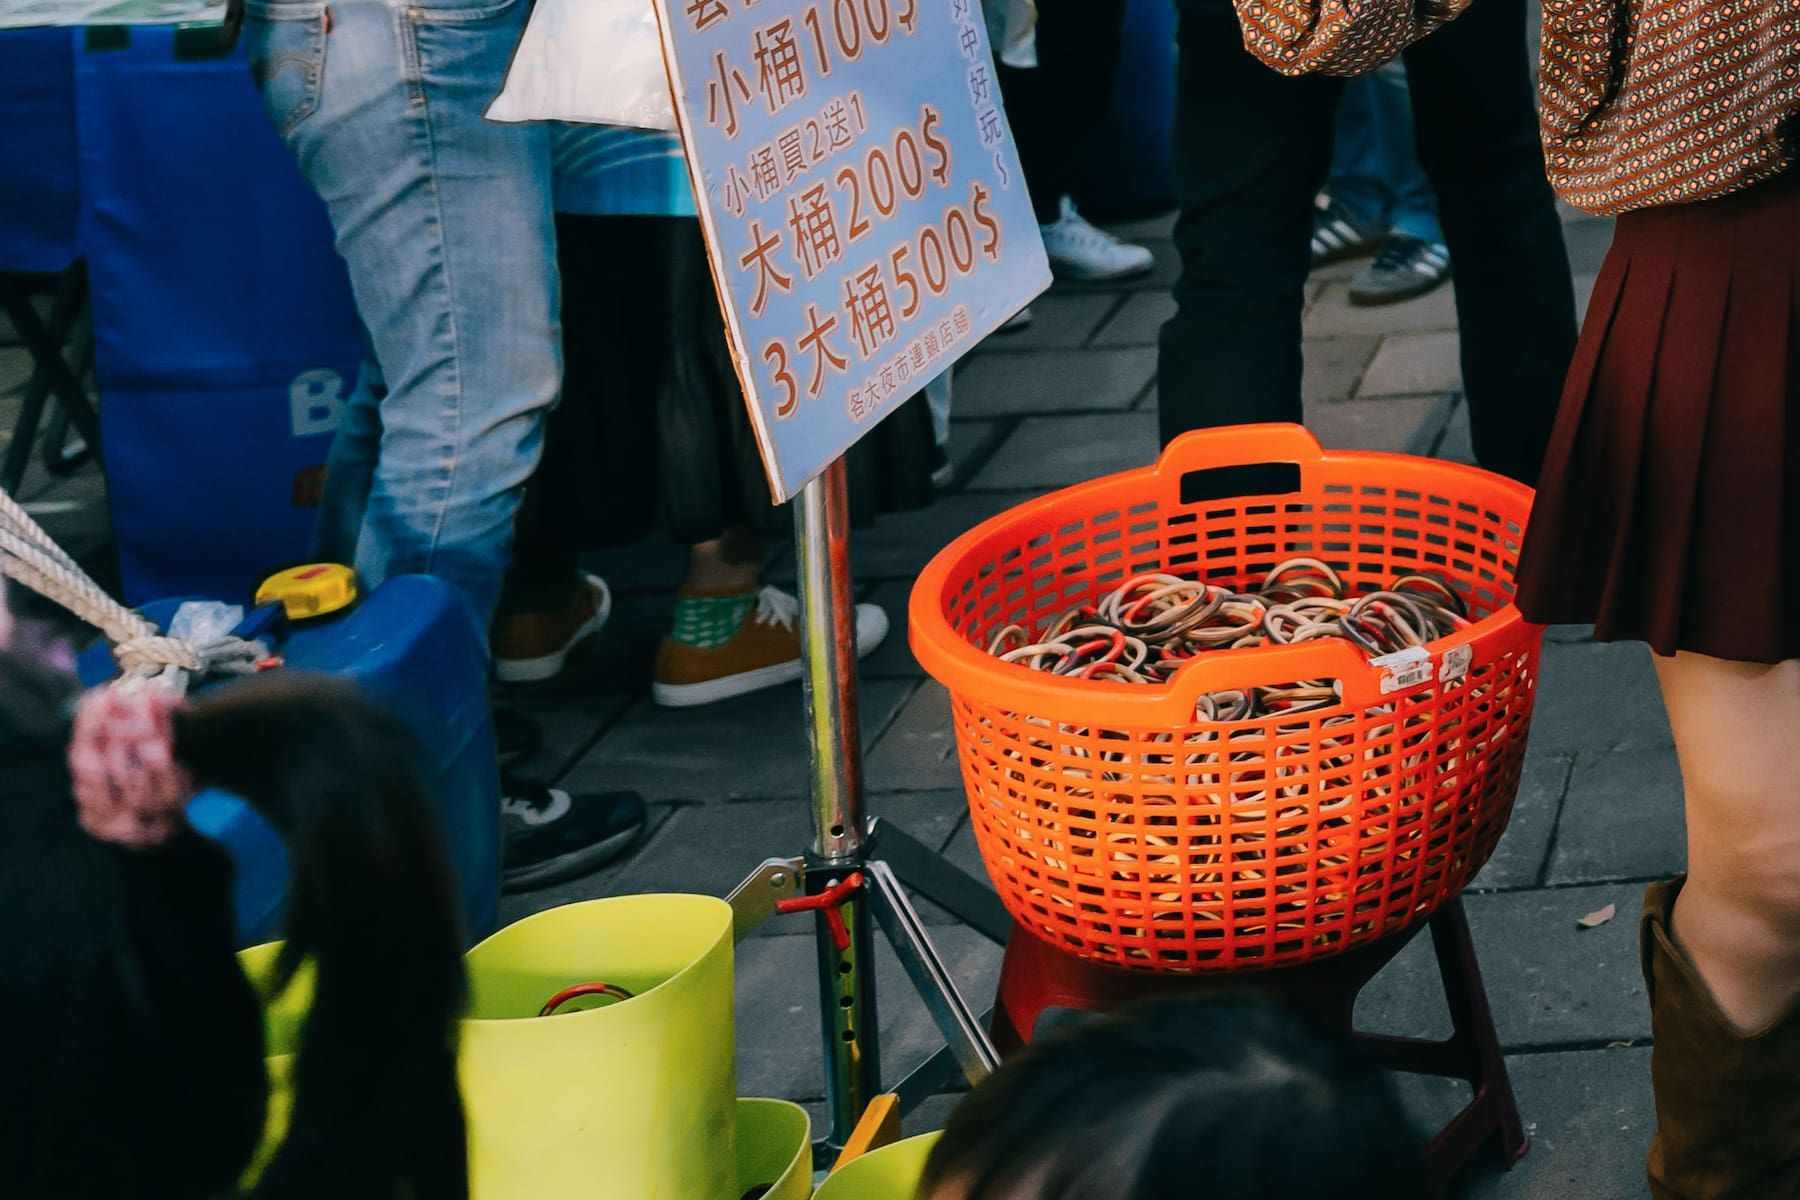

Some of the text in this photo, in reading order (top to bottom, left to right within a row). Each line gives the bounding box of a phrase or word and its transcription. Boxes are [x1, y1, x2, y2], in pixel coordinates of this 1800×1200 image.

[724, 93, 867, 216] 小桶買2送1
[740, 108, 949, 314] 大桶200$
[763, 184, 1000, 418] 3大桶500$
